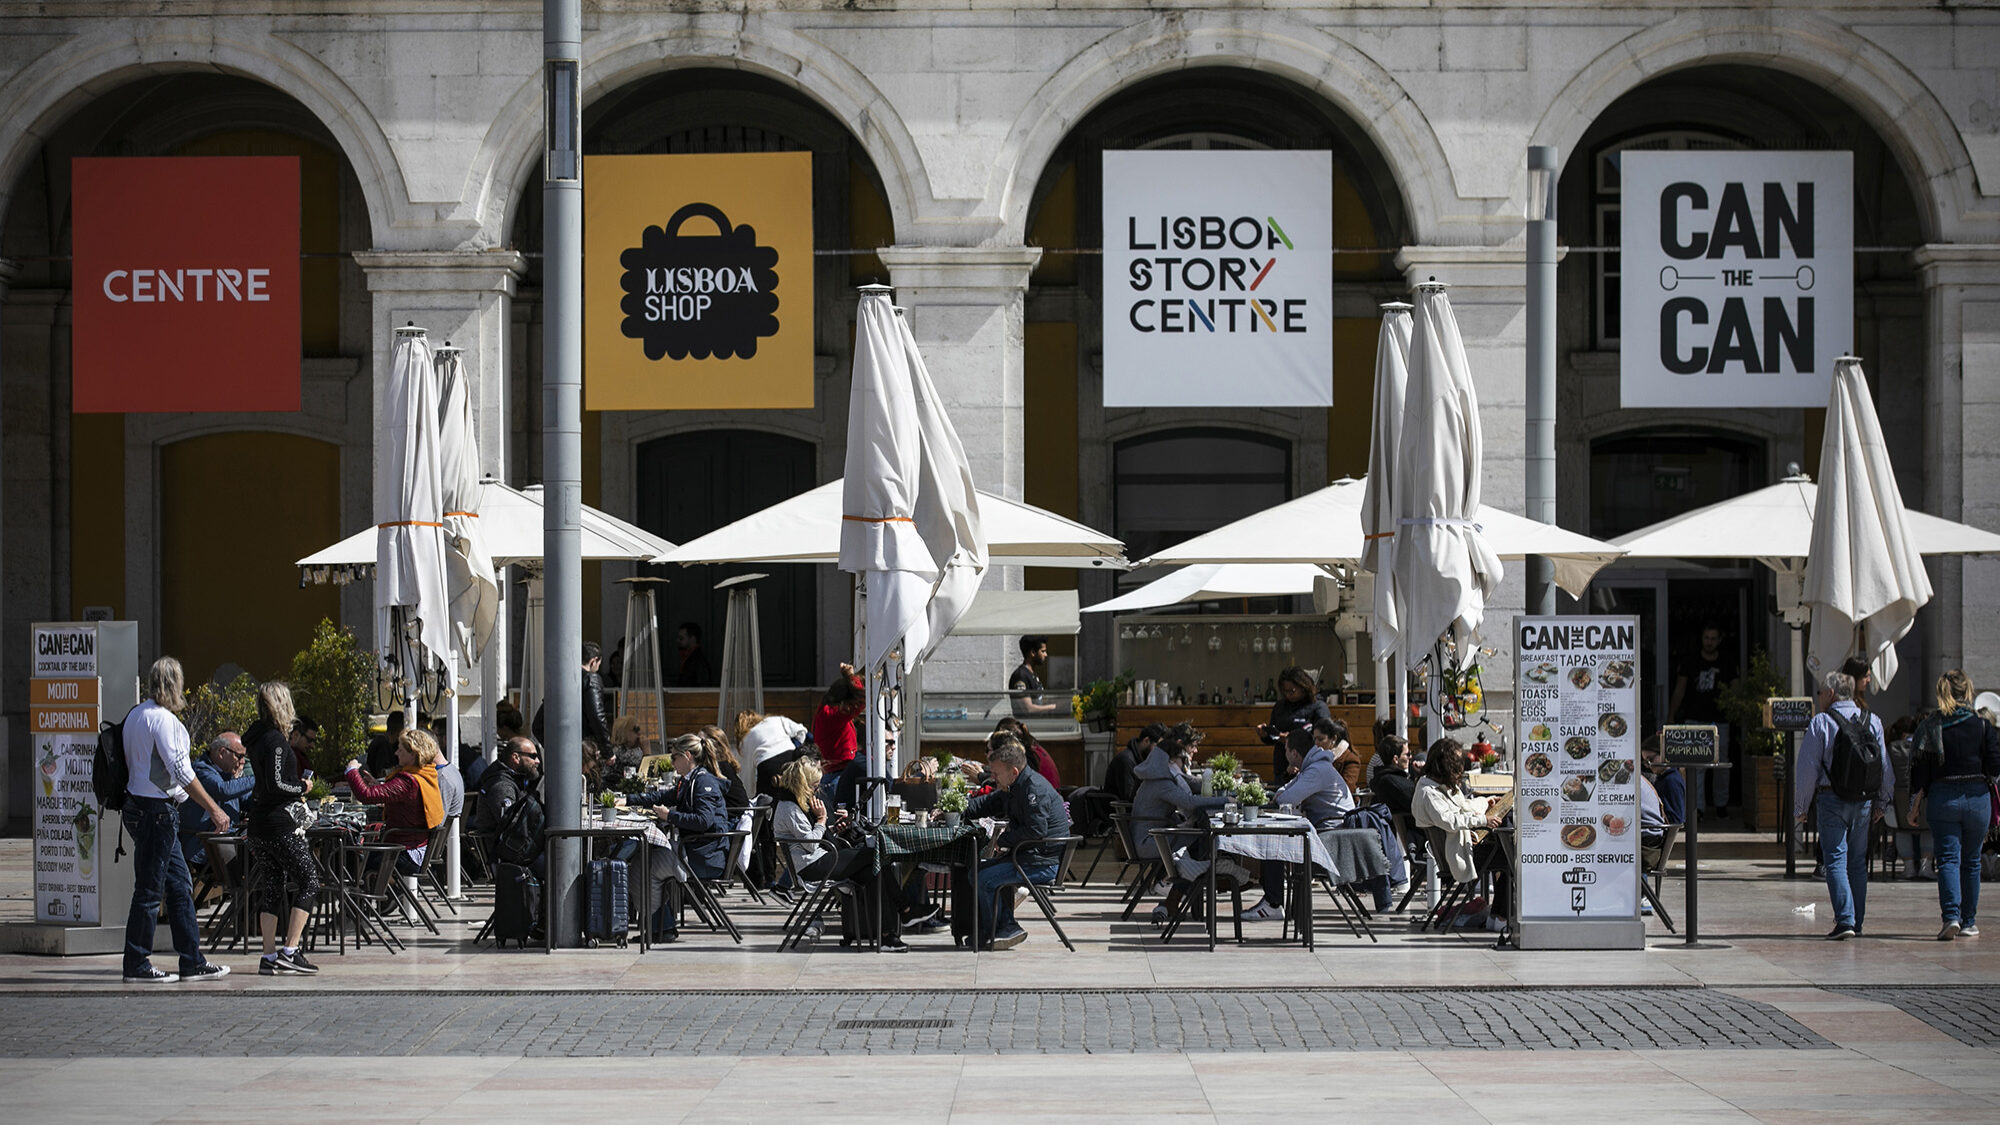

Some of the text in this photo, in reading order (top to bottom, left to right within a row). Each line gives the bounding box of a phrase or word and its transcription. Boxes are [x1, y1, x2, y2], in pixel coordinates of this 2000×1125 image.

[1660, 182, 1815, 260] CAN
[1129, 216, 1294, 250] LISBOA
[1129, 257, 1276, 291] STORY
[1722, 270, 1753, 286] THE
[103, 269, 270, 302] CENTRE
[645, 267, 759, 294] LISBOA
[645, 295, 712, 321] SHOP
[1129, 299, 1307, 333] CENTRE
[1660, 296, 1815, 375] CAN
[1521, 625, 1634, 650] CAN THE CAN
[38, 633, 62, 655] CAN
[70, 633, 93, 655] CAN
[1521, 654, 1558, 662] BREAKFAST
[1560, 654, 1597, 667] TAPAS
[38, 662, 60, 672] COCKTAIL
[61, 662, 68, 672] OF
[69, 662, 78, 672] THE
[79, 662, 88, 672] DAY
[47, 683, 79, 700] MOJITO
[1521, 689, 1559, 699] TOASTS
[1598, 703, 1615, 712] FISH
[1773, 702, 1805, 710] MOJITO
[1521, 707, 1546, 717] EGGS
[38, 712, 90, 729] CAIPIRINHA
[1560, 726, 1596, 736] SALADS
[1666, 730, 1708, 740] MOJITO
[61, 743, 97, 756] CAIPIRINHA
[1521, 742, 1559, 752] PASTAS
[1666, 746, 1712, 756] CAIPIRINHA
[65, 759, 93, 776] MOJITO
[57, 780, 69, 792] DRY
[1521, 788, 1559, 797] DESSERTS
[1598, 794, 1635, 802] ICE CREAM
[37, 796, 76, 810] MARGUERITA
[42, 814, 61, 825] APEROL
[1560, 817, 1597, 825] KIDS MENU
[50, 829, 73, 840] COLADA
[40, 845, 58, 856] PORTO
[1521, 854, 1634, 863] GOOD FOOD BEST SERVICE
[37, 861, 74, 872] BLOODY MARY
[77, 884, 96, 894] SERVICE
